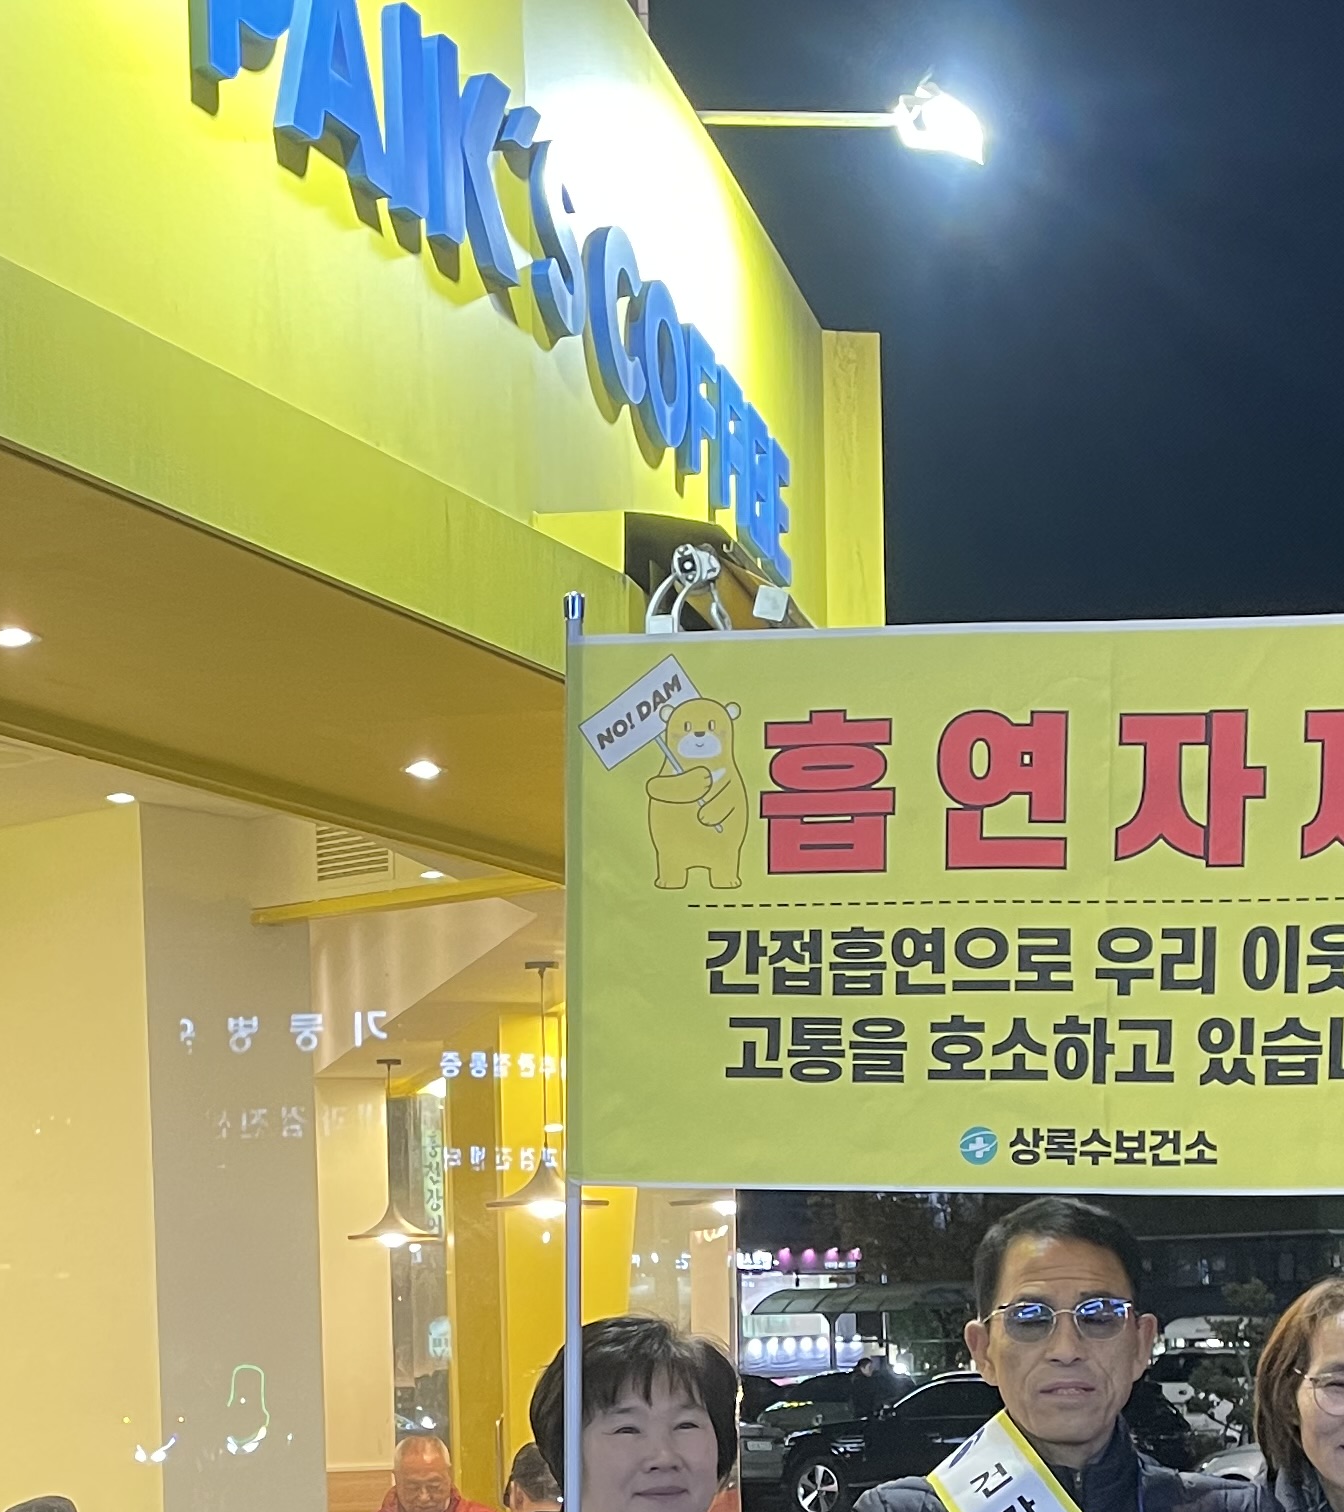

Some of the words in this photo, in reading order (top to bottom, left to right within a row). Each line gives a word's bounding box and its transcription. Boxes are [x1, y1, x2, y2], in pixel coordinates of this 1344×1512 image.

[583, 226, 792, 586] COFFEE
[597, 712, 636, 751] NO!
[636, 674, 683, 722] DAM
[704, 926, 1074, 997] 간접흡연으로
[1094, 927, 1215, 996] 우리
[724, 1018, 906, 1085] 고통을
[927, 1017, 1174, 1085] 호소하고
[1009, 1127, 1218, 1167] 상록수보건소
